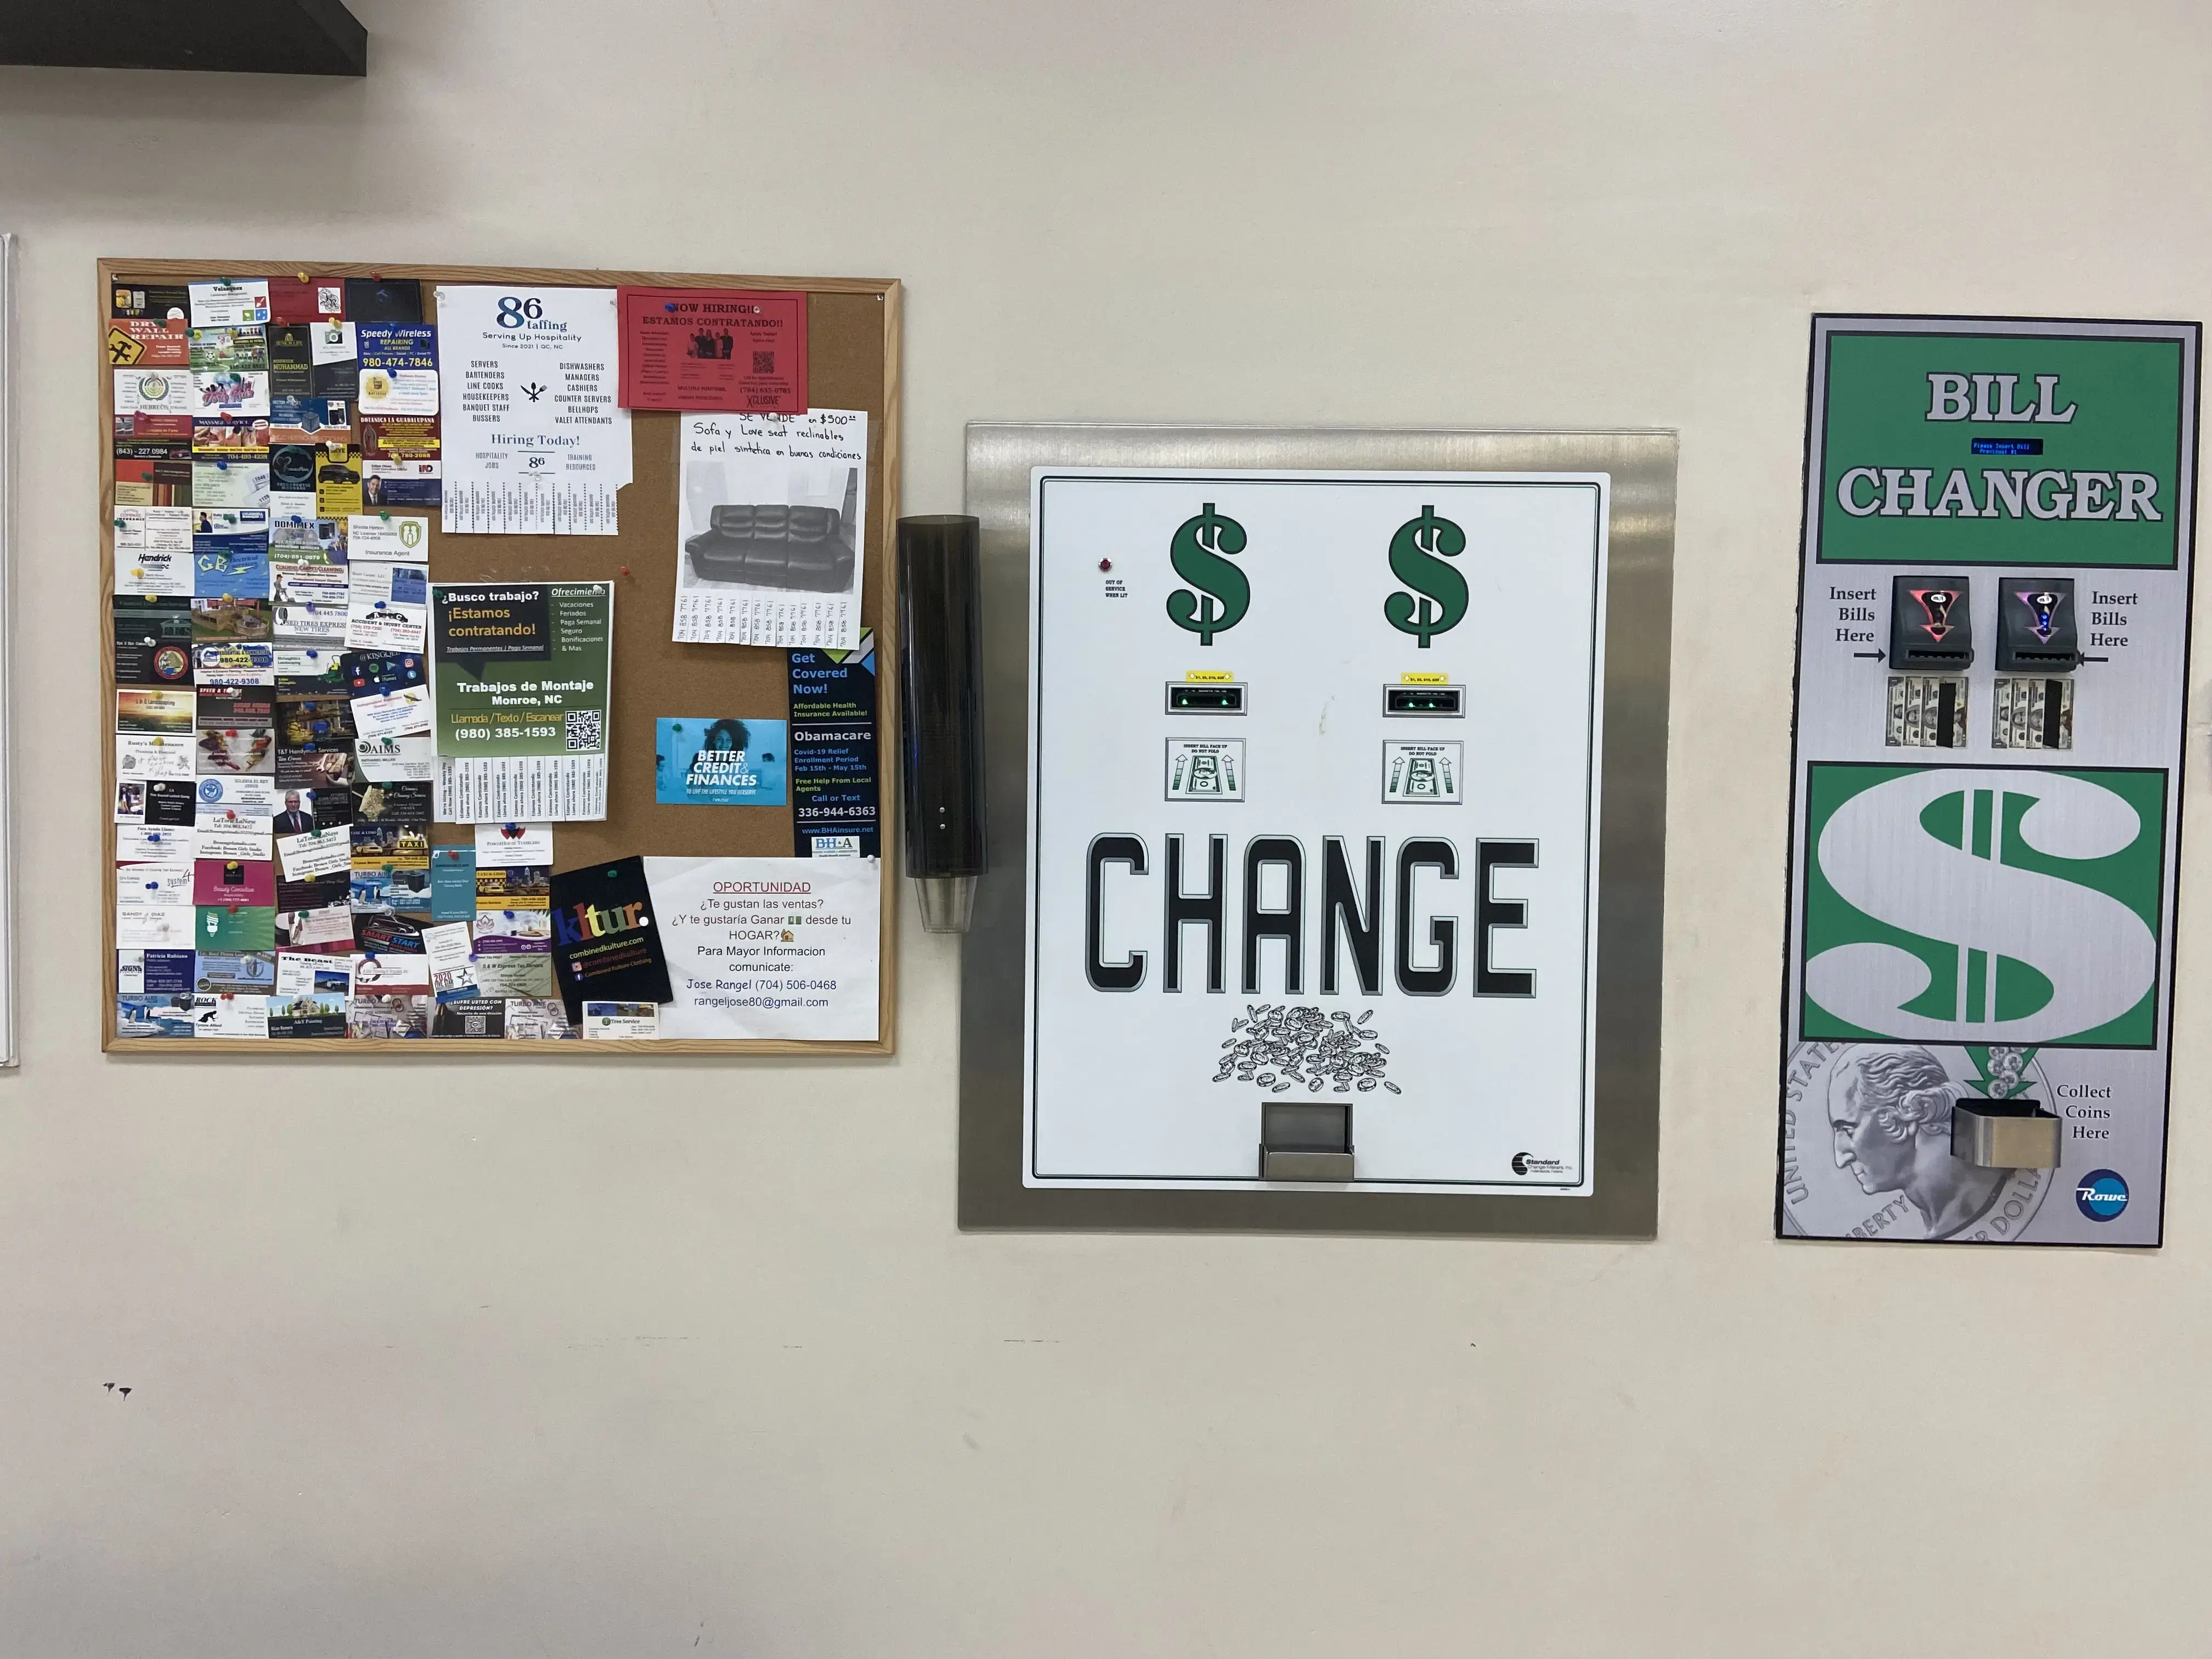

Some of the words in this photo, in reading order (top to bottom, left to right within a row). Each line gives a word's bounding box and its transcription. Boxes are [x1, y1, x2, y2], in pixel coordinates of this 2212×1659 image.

[496, 296, 543, 328] 86
[527, 320, 567, 332] taffing
[643, 317, 693, 325] ESTAMOS
[697, 318, 783, 328] CONTRATANDO!!
[361, 330, 392, 338] Speedy
[483, 332, 516, 341] Serving
[534, 334, 582, 342] Hospitality
[363, 358, 433, 366] 980-474-7846
[1925, 372, 2079, 424] BILL
[694, 422, 721, 435] Sofa
[741, 424, 763, 437] Love
[768, 428, 788, 437] seat
[797, 429, 844, 441] reclinables
[492, 435, 534, 447] Hiring
[538, 436, 579, 448] Today!
[691, 442, 701, 451] de
[709, 441, 726, 454] piel
[735, 442, 770, 455] sintetica
[789, 445, 813, 459] buenas
[819, 449, 861, 460] condiciones
[1836, 466, 2164, 522] CHANGER
[138, 554, 172, 563] Hendrick
[442, 592, 486, 604] ¿Busco
[489, 591, 539, 602] trabajo?
[1829, 586, 1877, 601] Insert
[2091, 591, 2138, 605] Insert
[449, 607, 510, 620] ¡Estamos
[1838, 608, 1875, 622] Bills
[2091, 612, 2127, 626] Bills
[449, 623, 535, 636] contratando!
[1836, 629, 1874, 642] Here
[2090, 633, 2129, 647] Here
[792, 653, 815, 663] Get
[792, 668, 848, 679] Covered
[457, 682, 517, 694] Trabajos
[521, 681, 537, 691] de
[541, 680, 594, 693] Montaje
[793, 684, 828, 694] Now!
[492, 696, 540, 706] Monroe,
[545, 695, 562, 704] NC
[455, 729, 490, 741] (980)
[495, 727, 556, 738] 385-1593
[794, 731, 871, 741] Obamacare
[371, 744, 400, 754] AIMS
[697, 751, 745, 761] BETTER
[686, 775, 757, 786] FINANCES
[798, 806, 876, 817] 336-944-6363
[713, 882, 811, 893] OPORTUNIDAD
[700, 899, 720, 910] ¿Te
[723, 900, 759, 911] gustan
[763, 899, 778, 909] las
[781, 899, 823, 909] ventas?
[672, 915, 686, 926] ¿Y
[690, 915, 700, 925] te
[703, 915, 747, 926] gustaría
[751, 915, 785, 925] Ganar
[805, 915, 838, 924] desde
[841, 916, 851, 924] tu
[1085, 832, 1539, 998] CHANGE
[729, 930, 780, 940] HOGAR?
[569, 936, 644, 959] combinedkulture.com
[698, 946, 723, 956] Para
[726, 946, 760, 958] Mayor
[764, 946, 825, 956] Informacion
[729, 962, 793, 972] comunicate:
[687, 979, 712, 989] Jose
[715, 979, 752, 991] Rangel
[755, 980, 782, 991] (704)
[787, 980, 836, 990] 506-0468
[694, 996, 828, 1008] rangeljose80@gmail.com
[1787, 1042, 1847, 1101] STATE
[2056, 1085, 2112, 1099] Collect
[2065, 1105, 2111, 1119] Coins
[2072, 1126, 2109, 1140] Here
[2075, 1187, 2129, 1202] Rowe
